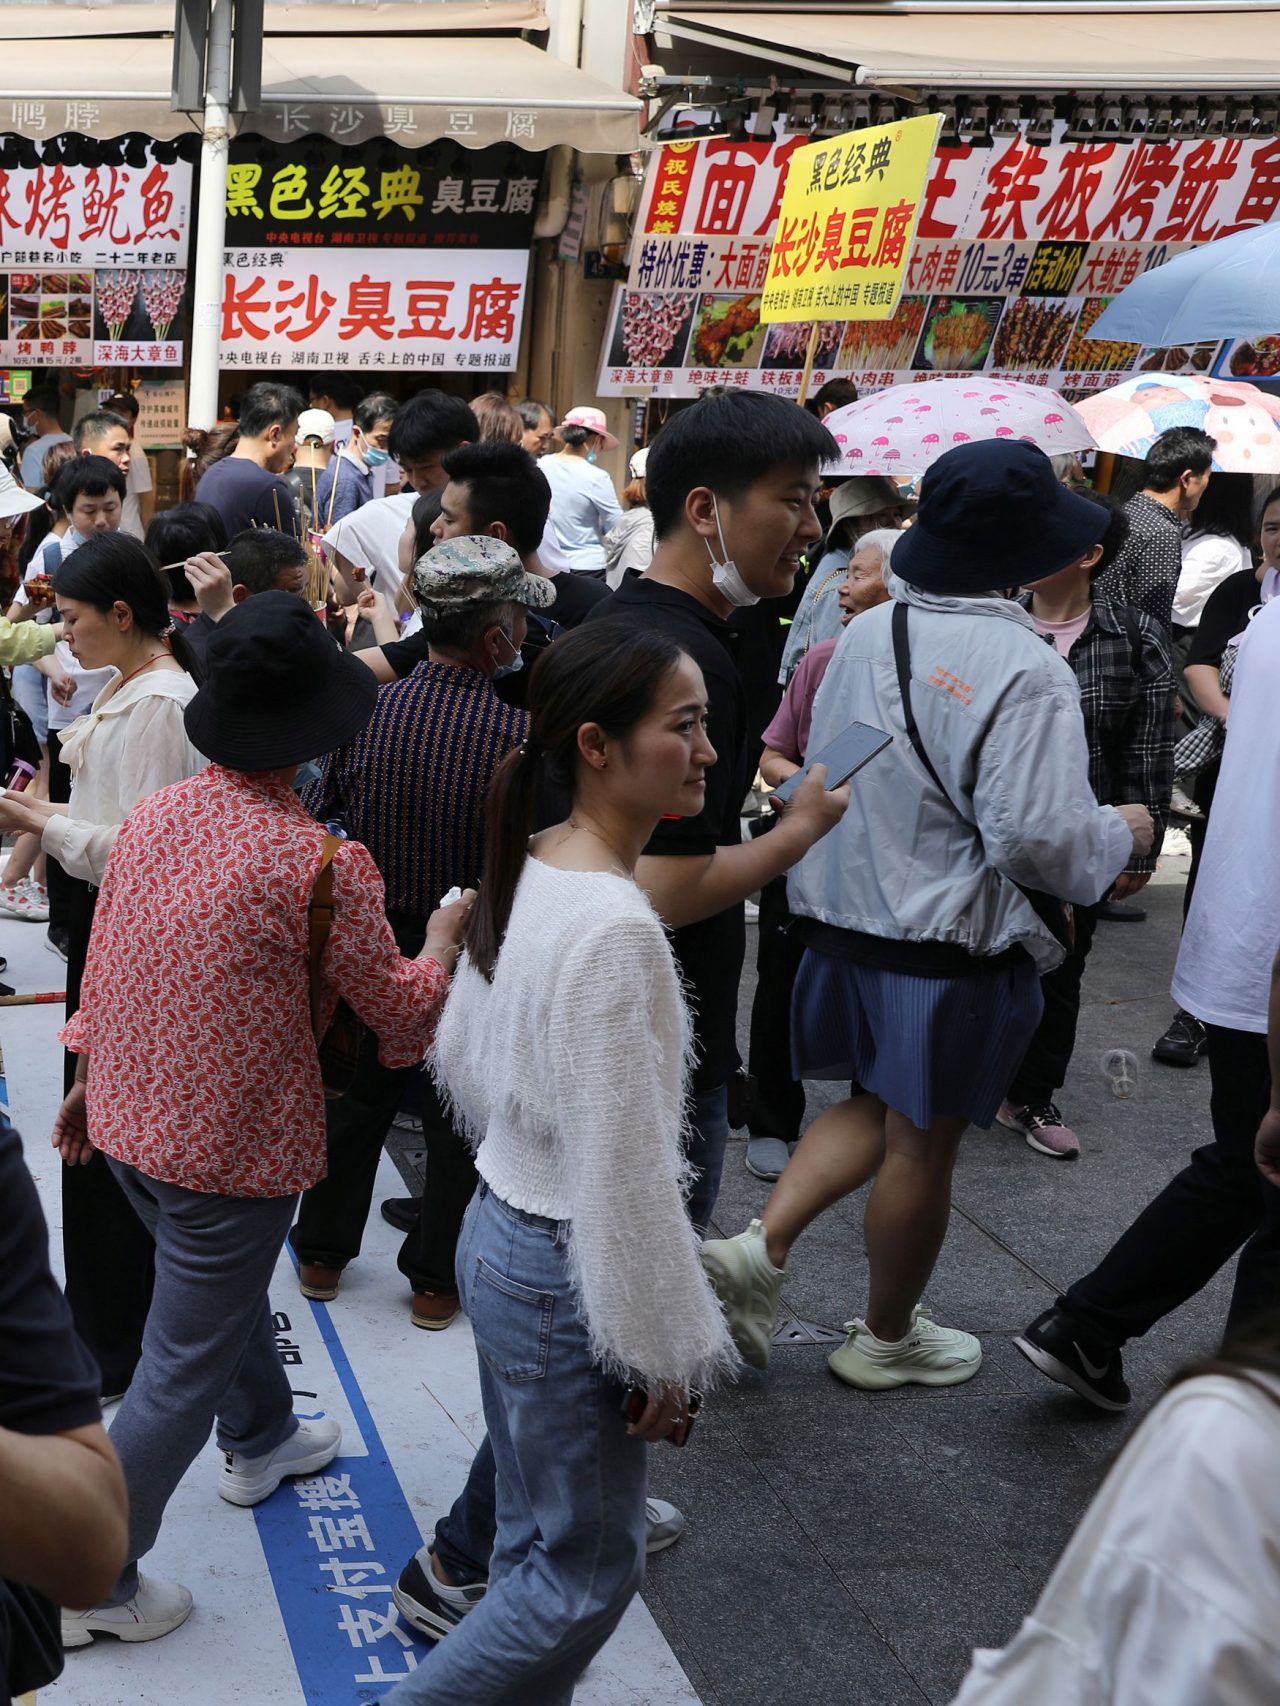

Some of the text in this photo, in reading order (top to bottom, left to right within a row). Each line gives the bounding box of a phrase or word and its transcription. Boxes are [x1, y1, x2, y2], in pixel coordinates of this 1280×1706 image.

[275, 104, 538, 139] 长沙臭豆腐
[806, 136, 892, 195] 黑色经典
[225, 163, 424, 222] 黑色经典
[431, 176, 539, 216] 臭豆腐
[772, 199, 916, 279] 长沙臭豆腐
[1, 251, 177, 265] 户部巷名小吃 二十二年老店
[1024, 244, 1081, 291] 活动价
[863, 280, 896, 306] 专题报道
[221, 274, 522, 344] 长沙臭豆腐
[17, 342, 77, 356] 烤鸭脖
[98, 345, 178, 362] 深海大章鱼
[291, 351, 350, 366] 湖南卫视
[358, 351, 445, 367] 舌尖上的中国
[454, 351, 513, 367] 专题报道
[609, 369, 674, 385] 深海大章鱼
[687, 371, 750, 386] 绝味牛蛙
